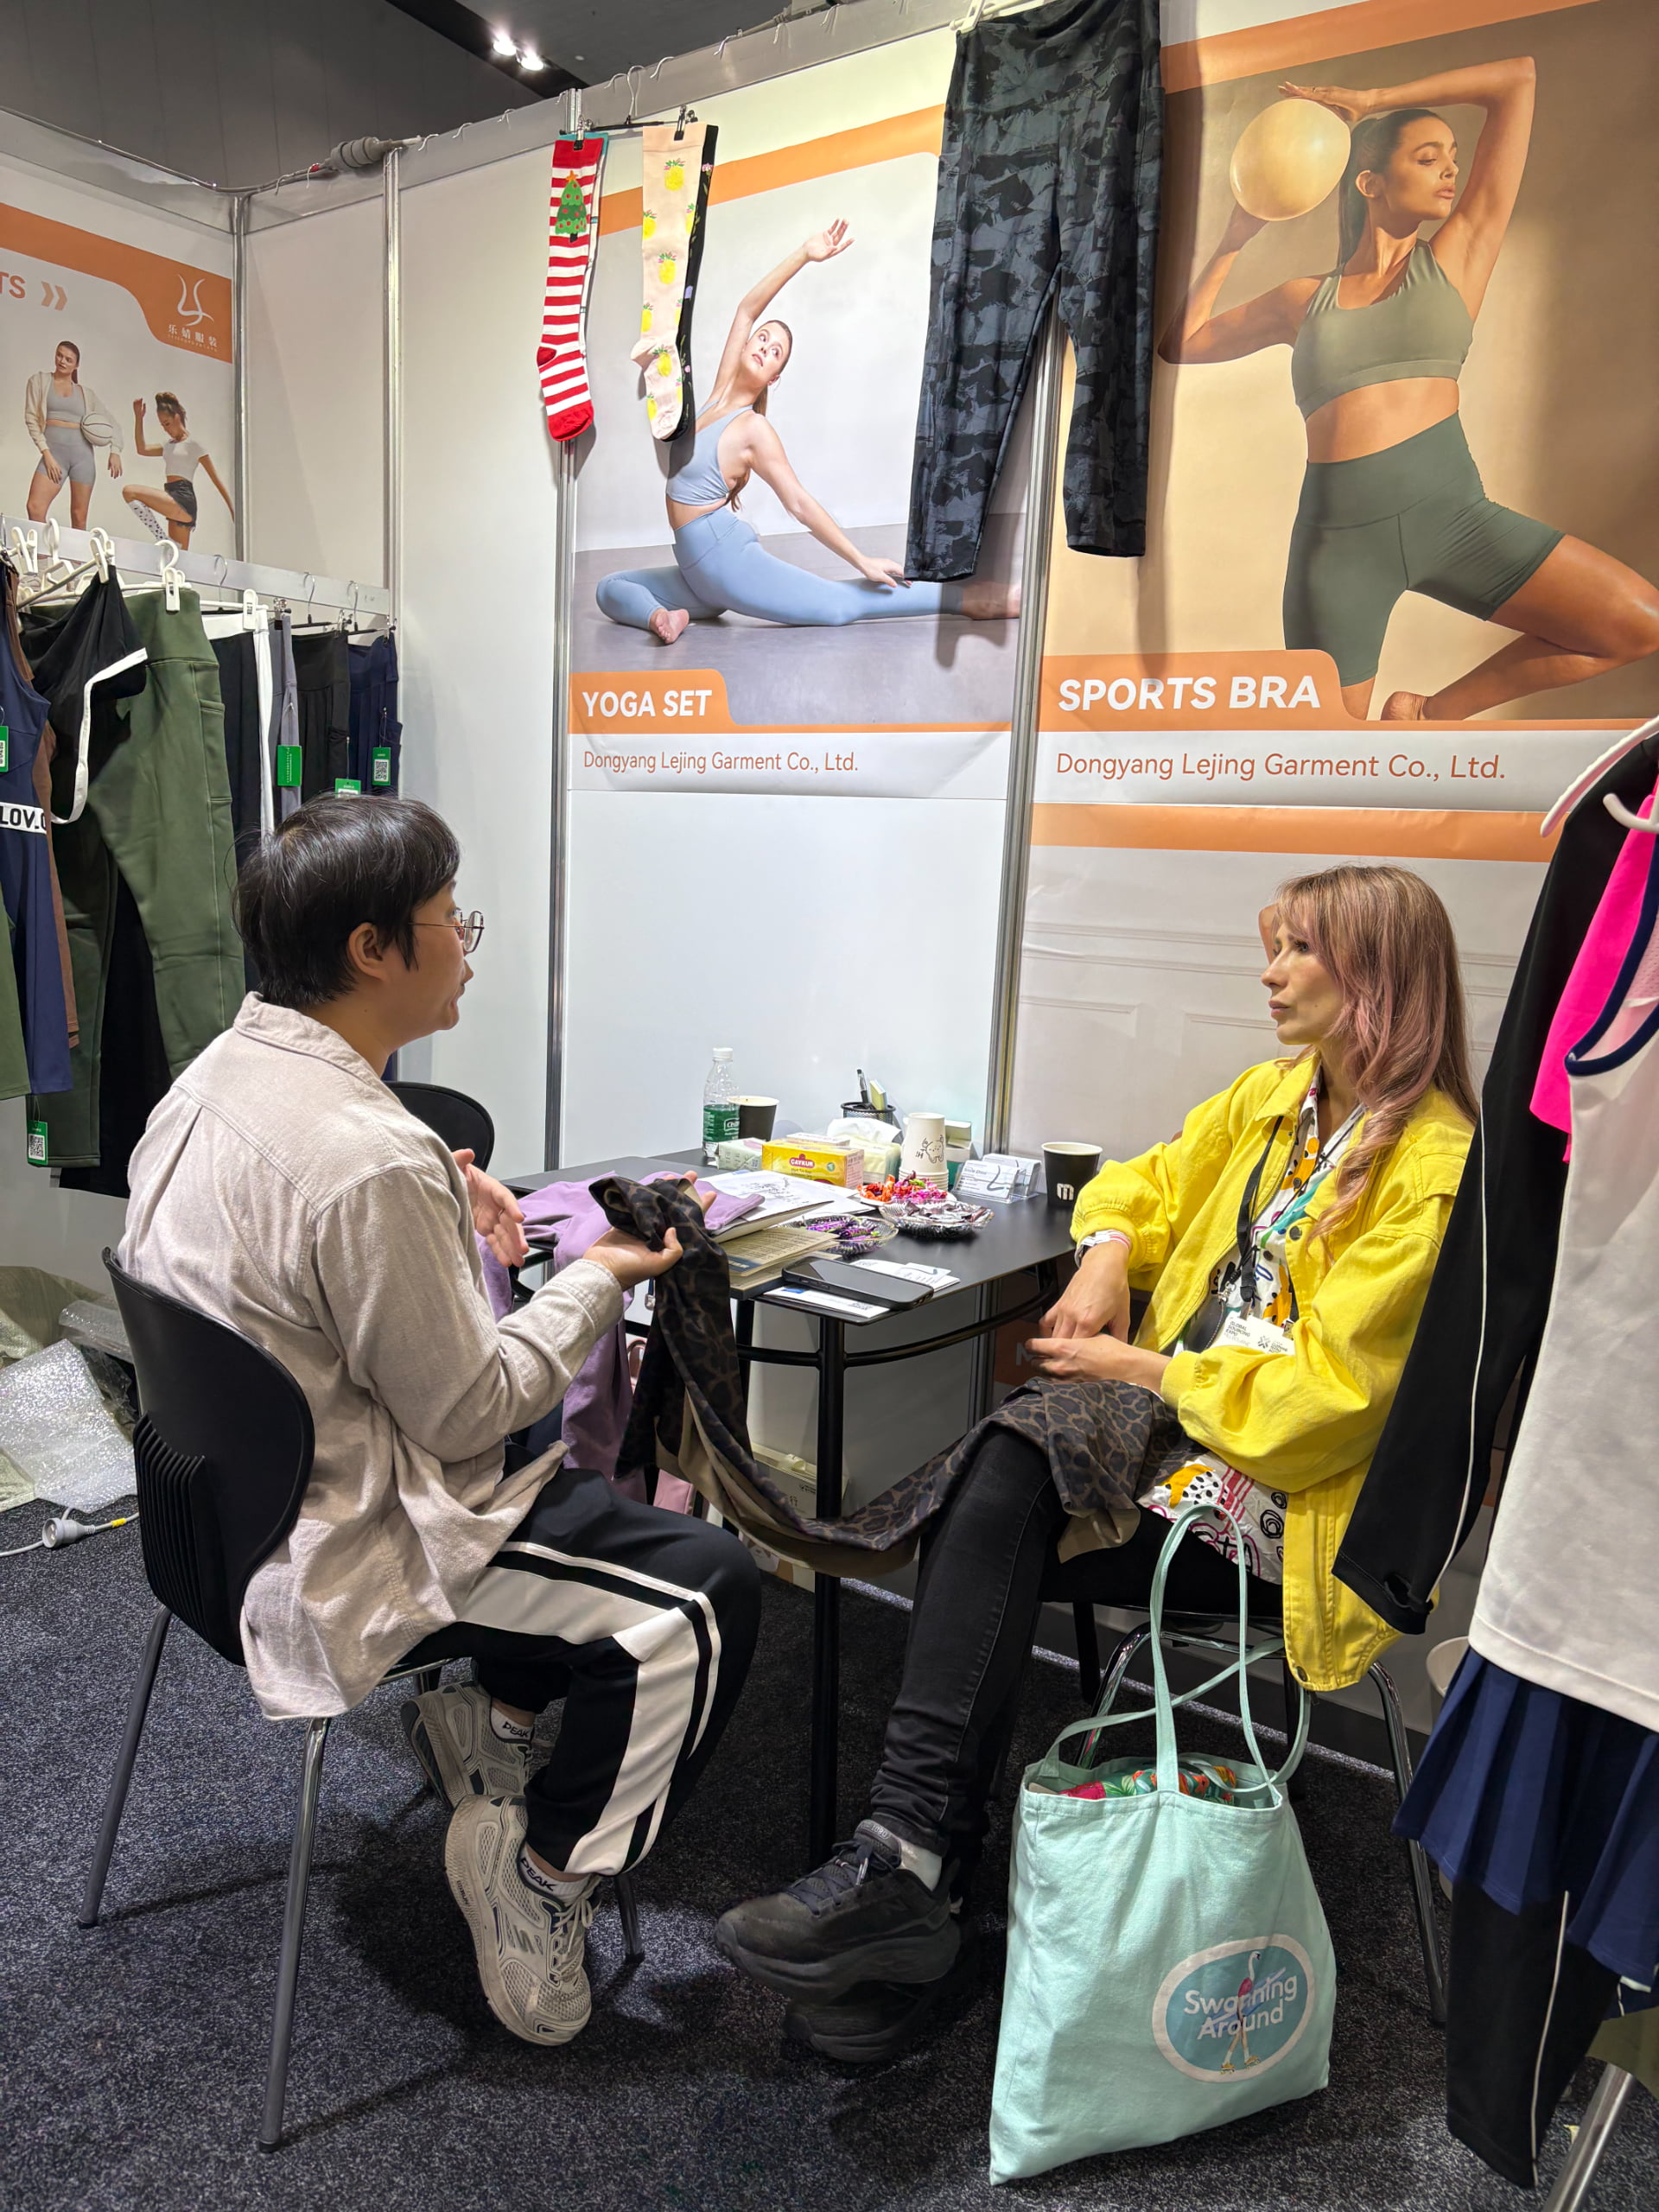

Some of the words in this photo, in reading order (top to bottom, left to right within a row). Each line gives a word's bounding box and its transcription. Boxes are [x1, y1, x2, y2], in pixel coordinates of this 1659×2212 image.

[582, 690, 656, 717] YOGA
[662, 690, 713, 717] SET
[1058, 677, 1217, 711] SPORTS
[1229, 675, 1321, 709] BRA
[583, 750, 657, 774] Dongyang
[661, 752, 707, 774] Lejing
[711, 751, 782, 770] Garment
[787, 752, 819, 774] Co.,
[824, 752, 858, 771] Ltd.
[1057, 753, 1174, 780] Dongyang
[1182, 753, 1255, 781] Lejing
[1264, 753, 1380, 776] Garment
[1389, 754, 1440, 781] Co.,
[1451, 754, 1505, 779] Ltd.
[502, 1720, 530, 1738] PEAK
[520, 1856, 556, 1892] PEAK
[1184, 1975, 1298, 2015] Swanning
[1197, 1999, 1284, 2040] Around
